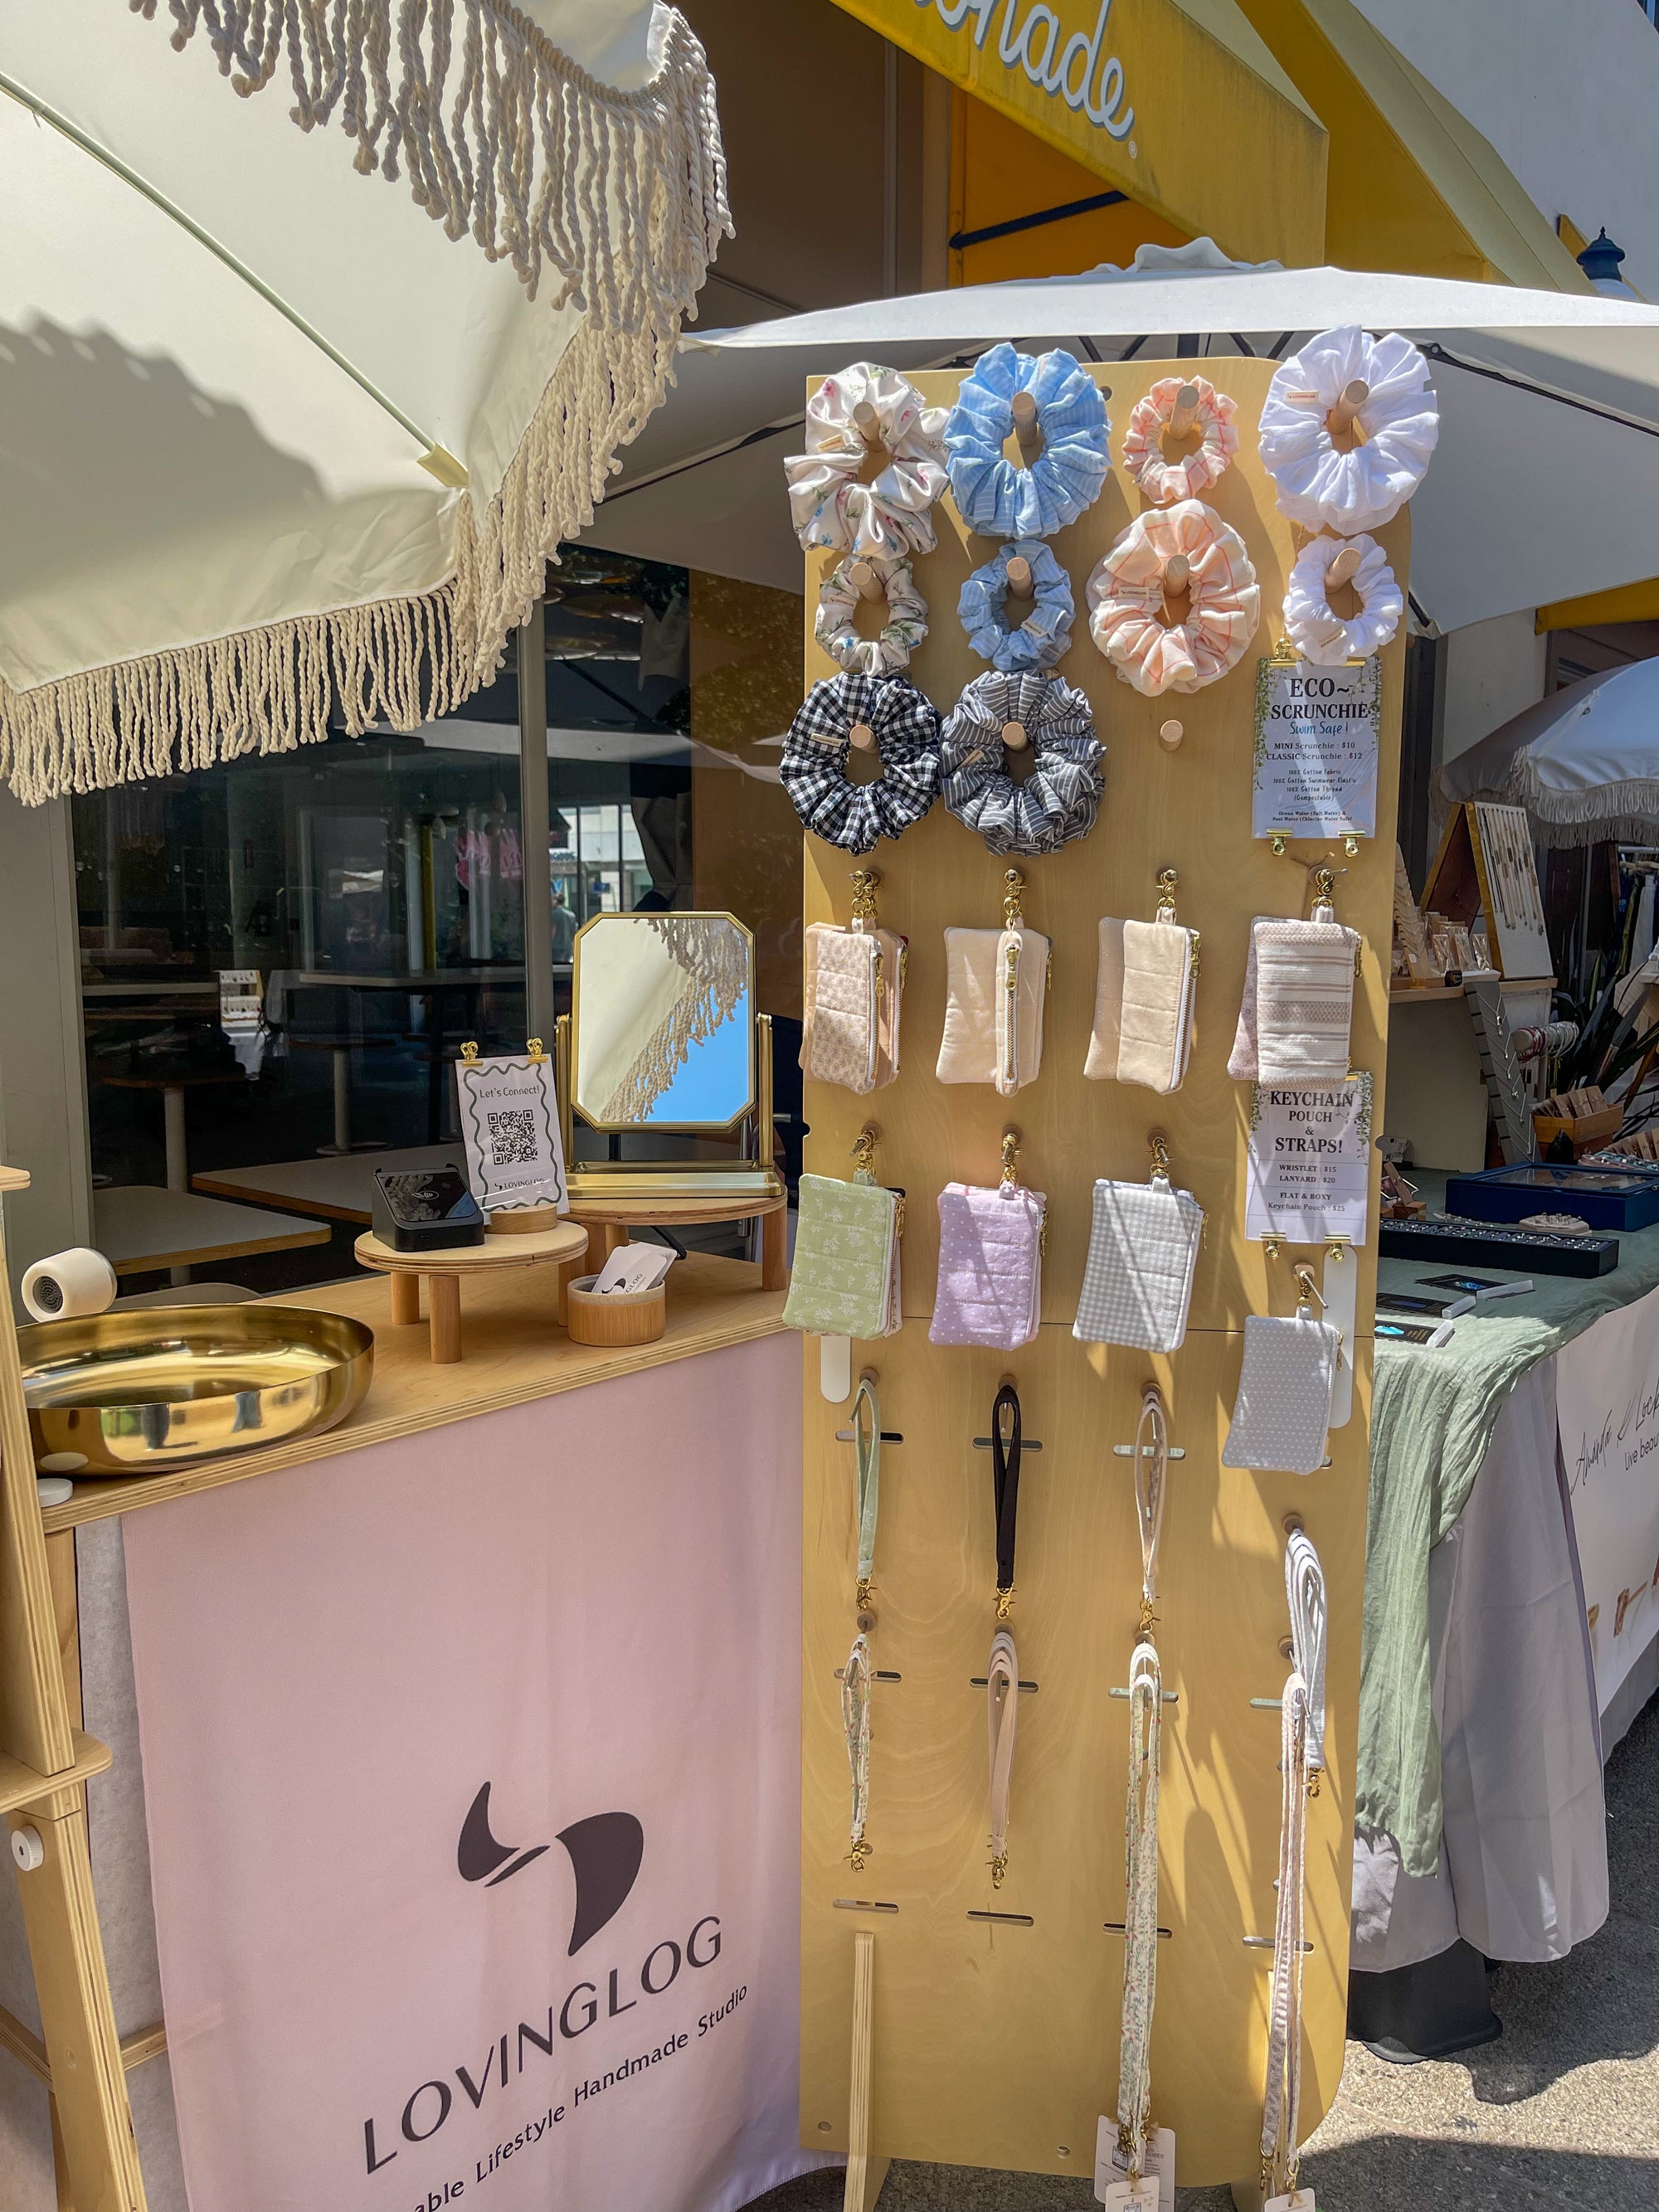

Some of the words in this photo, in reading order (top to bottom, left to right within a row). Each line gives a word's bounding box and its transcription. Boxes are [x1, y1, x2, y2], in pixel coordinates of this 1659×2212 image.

[1271, 703, 1368, 719] SCRUNCHIE
[1290, 721, 1316, 734] Swim
[479, 1087, 502, 1099] Let's
[503, 1085, 539, 1096] Connect!
[1270, 1091, 1354, 1107] KEYCHAIN
[1289, 1110, 1332, 1123] POUCH
[1305, 1125, 1314, 1135] &
[1275, 1137, 1343, 1154] STRAPS!
[1624, 1449, 1638, 1471] Live
[363, 1916, 722, 2175] LOVINGLOG
[476, 2104, 566, 2184] Lifestyle
[573, 2034, 688, 2107] Handmade
[698, 1986, 748, 2037] Studio
